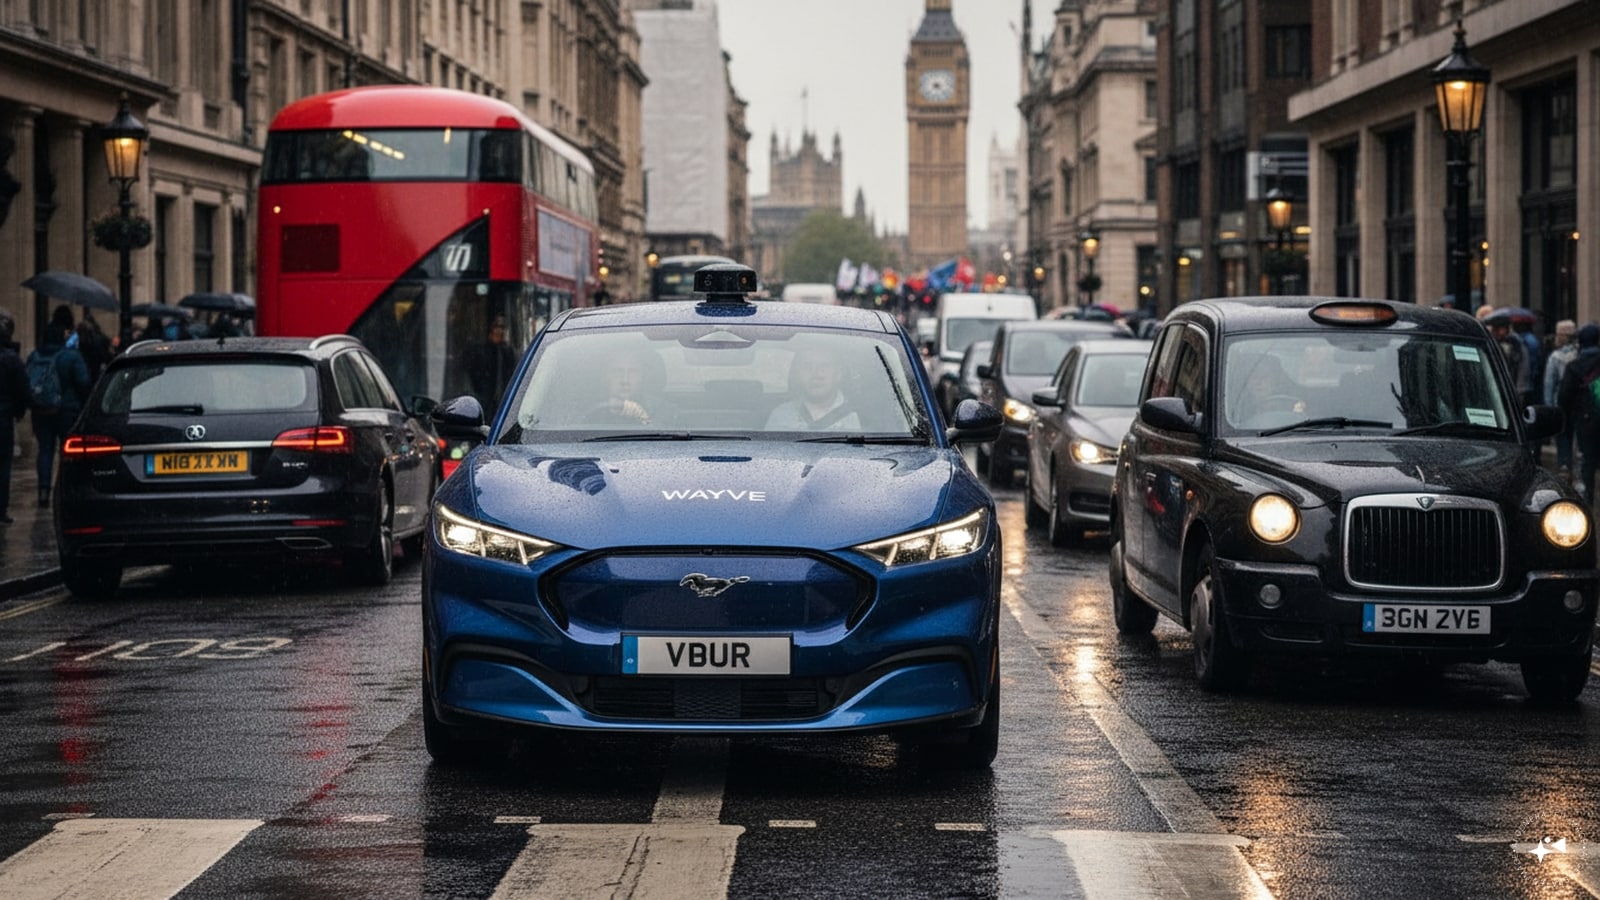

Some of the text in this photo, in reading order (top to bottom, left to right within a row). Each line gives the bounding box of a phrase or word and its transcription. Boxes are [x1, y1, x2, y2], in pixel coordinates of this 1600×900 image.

[661, 489, 767, 502] WAYVE
[1381, 607, 1428, 629] 3GN
[665, 642, 751, 668] VBUR
